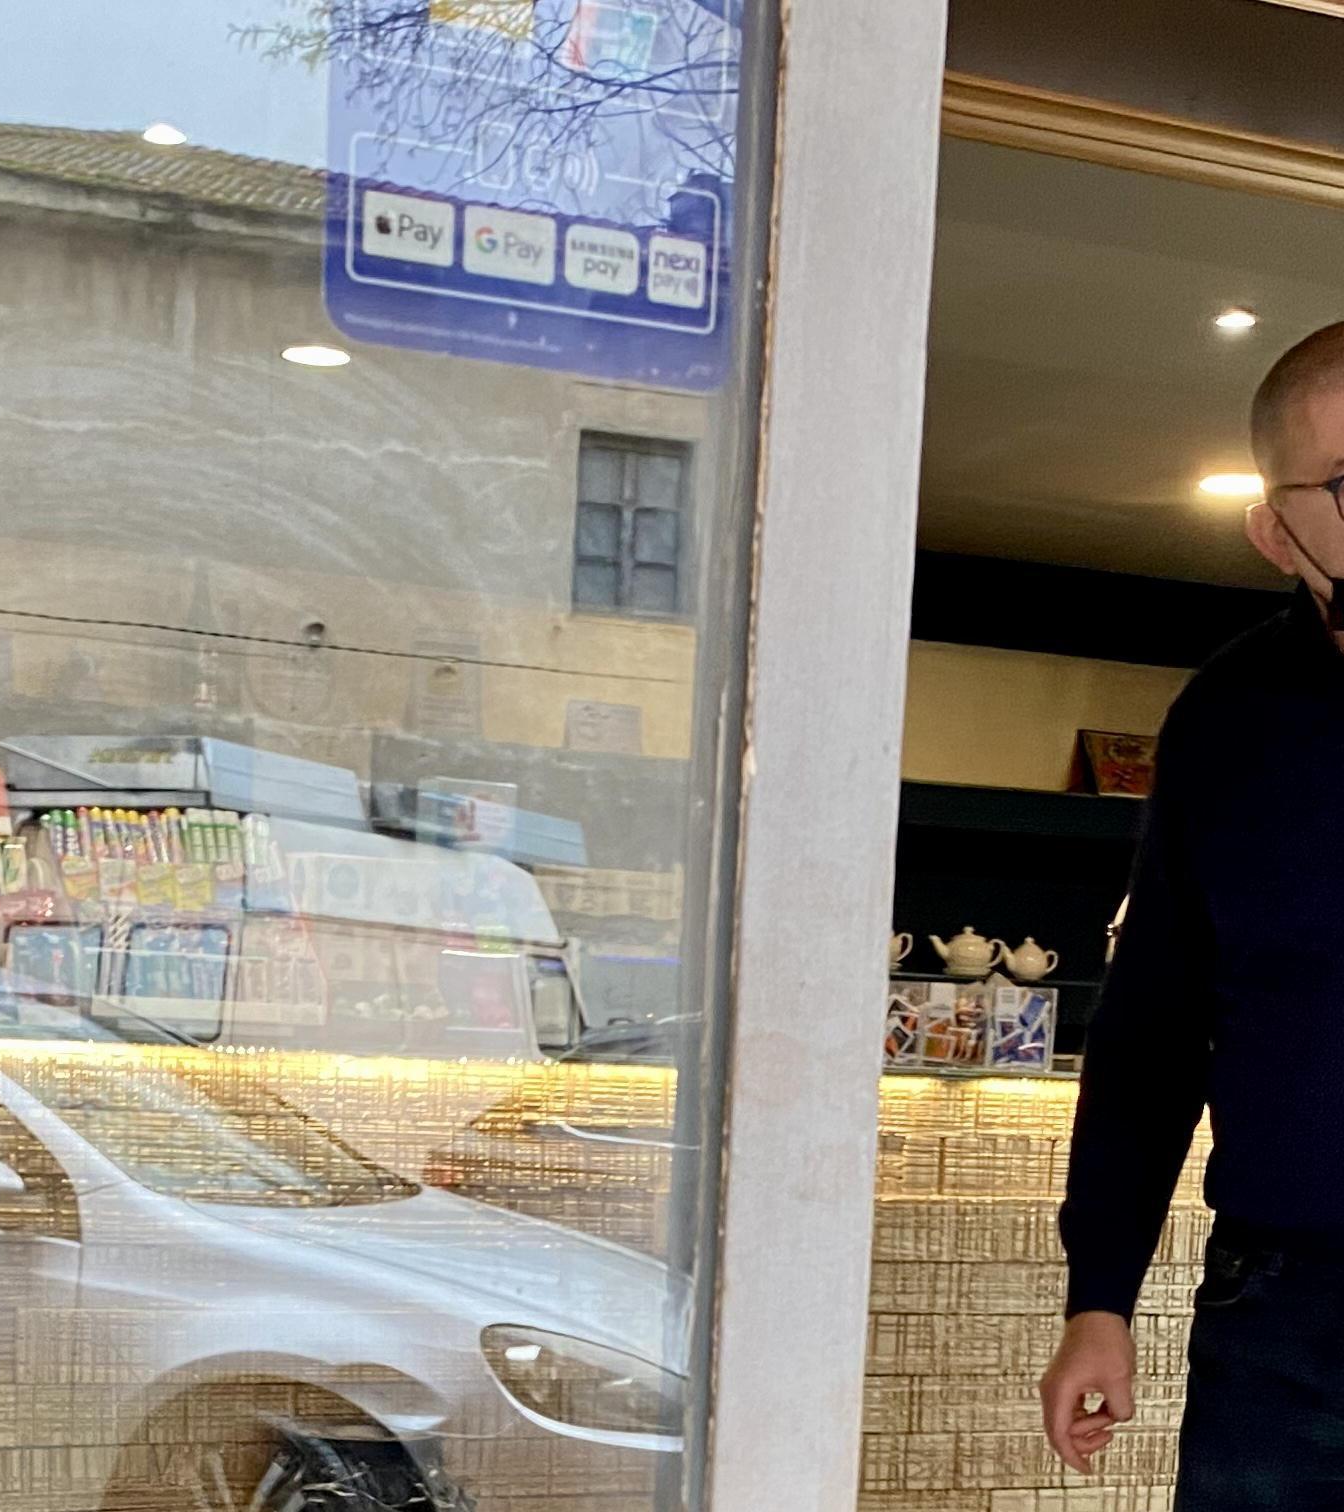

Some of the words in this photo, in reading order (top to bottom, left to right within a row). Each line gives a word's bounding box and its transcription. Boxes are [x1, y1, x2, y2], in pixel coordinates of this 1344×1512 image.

[398, 213, 443, 249] Pay
[504, 232, 544, 265] Pay
[654, 251, 701, 273] nexi
[583, 258, 621, 280] pay
